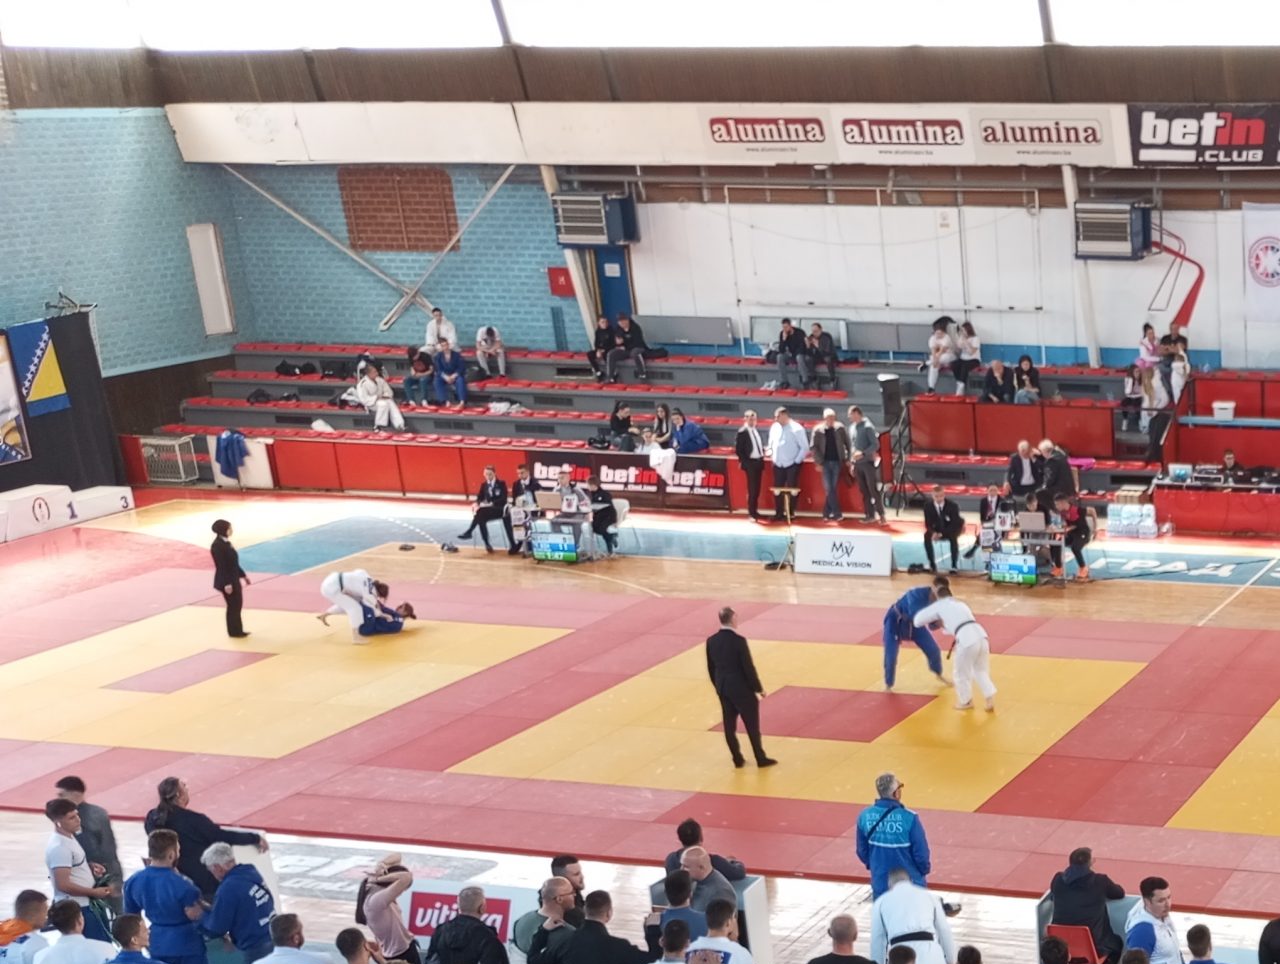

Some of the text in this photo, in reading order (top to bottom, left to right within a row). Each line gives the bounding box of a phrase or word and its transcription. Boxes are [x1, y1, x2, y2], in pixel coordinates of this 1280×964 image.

[712, 119, 825, 142] alumina
[845, 120, 963, 145] alumina
[983, 121, 1101, 143] alumina
[1140, 111, 1266, 146] betin
[600, 465, 659, 484] betin
[66, 502, 78, 519] 1
[120, 496, 129, 509] 3
[811, 560, 845, 568] MEDICAL
[415, 902, 504, 929] vitia
